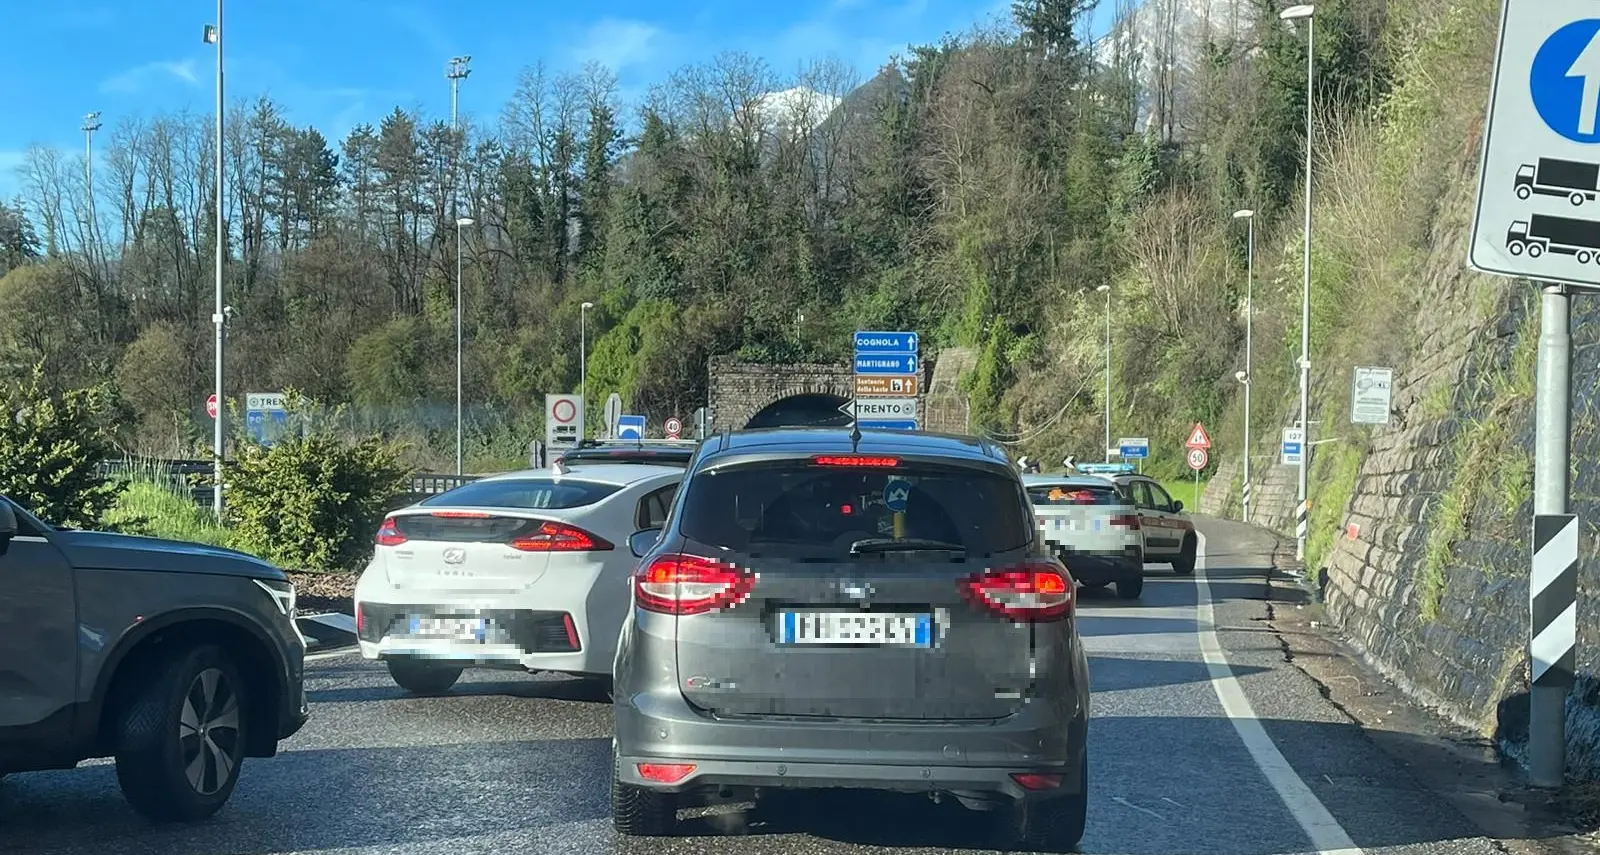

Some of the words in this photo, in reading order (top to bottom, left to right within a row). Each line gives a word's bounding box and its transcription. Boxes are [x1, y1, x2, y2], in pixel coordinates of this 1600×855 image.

[856, 338, 900, 346] COGNOLA
[856, 360, 900, 368] MARTIGNANO
[260, 397, 285, 406] TREN
[857, 404, 901, 413] TRENTO
[667, 421, 678, 431] 40
[1191, 453, 1203, 463] 50
